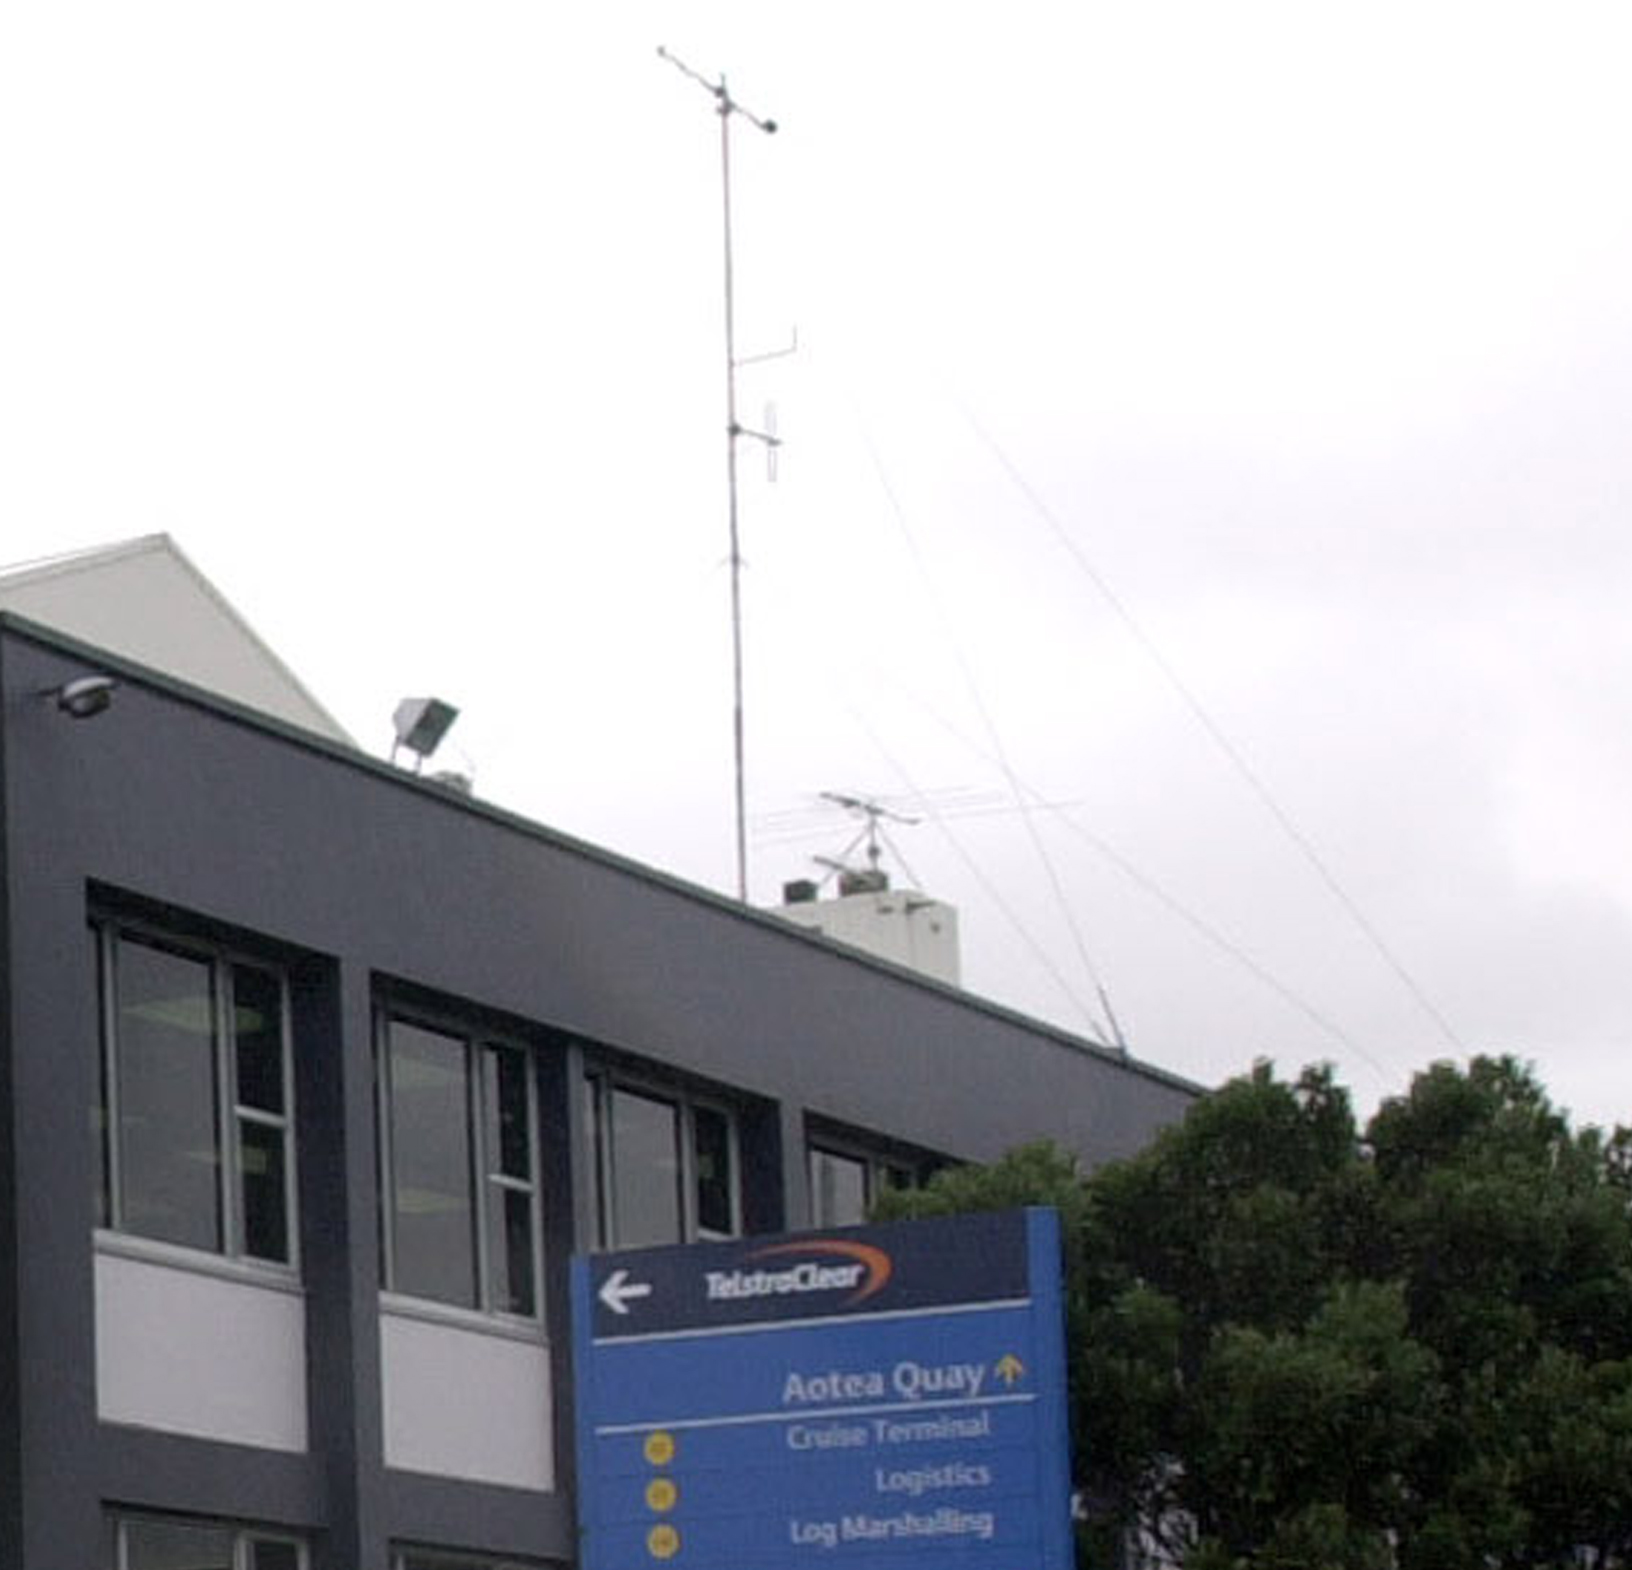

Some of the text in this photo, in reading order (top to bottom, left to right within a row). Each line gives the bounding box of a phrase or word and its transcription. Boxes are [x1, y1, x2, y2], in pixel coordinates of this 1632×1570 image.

[705, 1263, 865, 1299] TelstraClear
[782, 1360, 985, 1401] Aotea Quay
[787, 1411, 990, 1451] Cruise Terminal
[875, 1461, 991, 1494] Logistics
[790, 1508, 994, 1546] Log Marshalling
